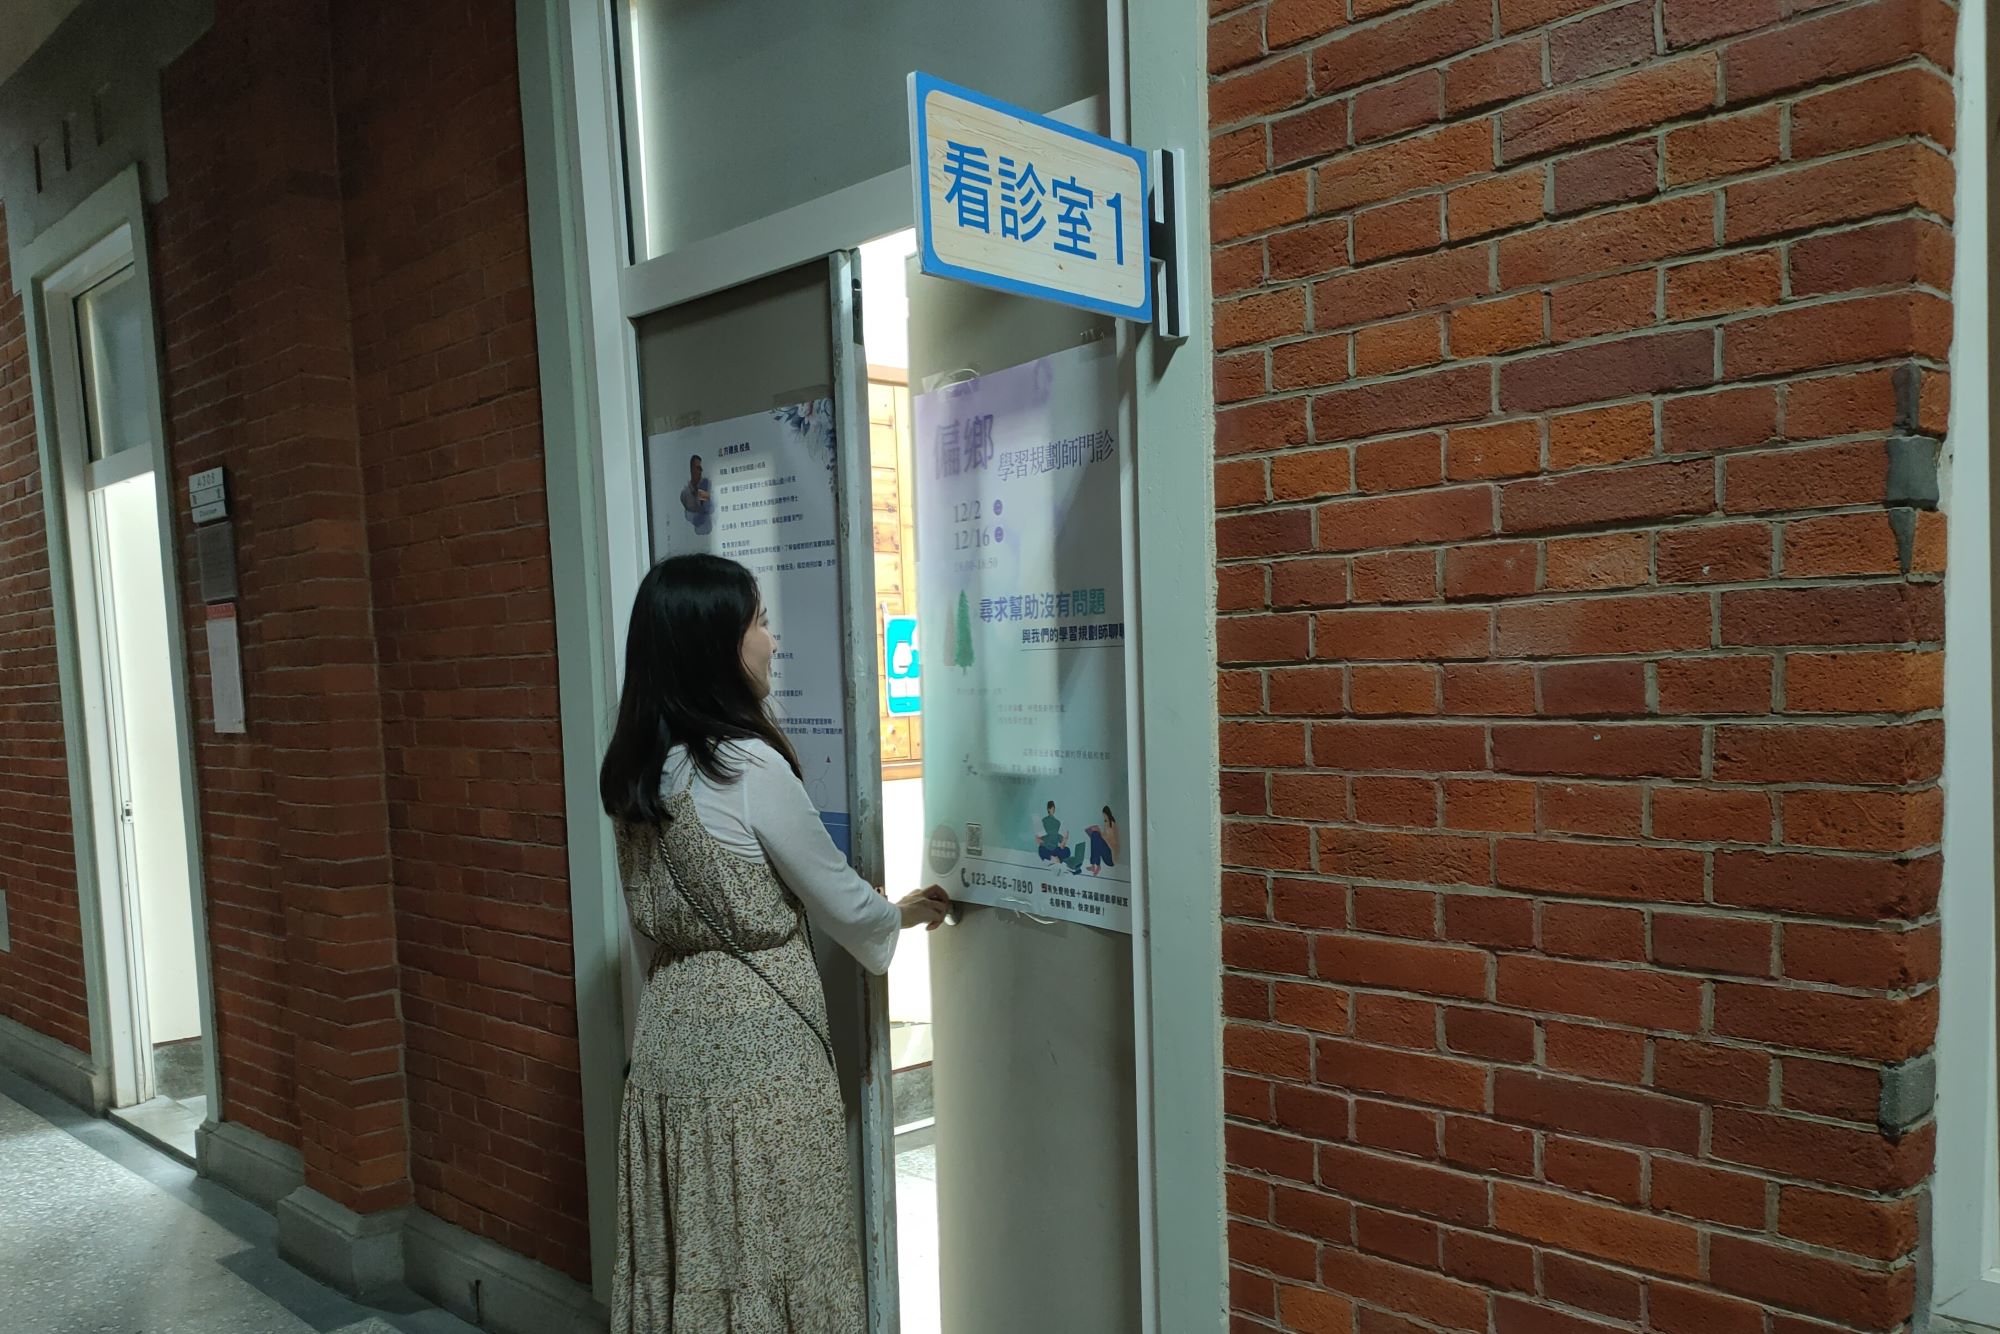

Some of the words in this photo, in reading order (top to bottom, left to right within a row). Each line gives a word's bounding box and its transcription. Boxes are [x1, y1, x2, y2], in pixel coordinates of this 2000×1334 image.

[943, 139, 1125, 266] 看診室1
[935, 413, 994, 480] 偏鄉
[997, 429, 1115, 482] 學習規劃師門診
[952, 500, 983, 524] 12/2
[954, 525, 990, 552] 12/16
[979, 587, 1106, 623] 尋求幫助沒有問題
[970, 872, 1033, 895] 123-456-7890
